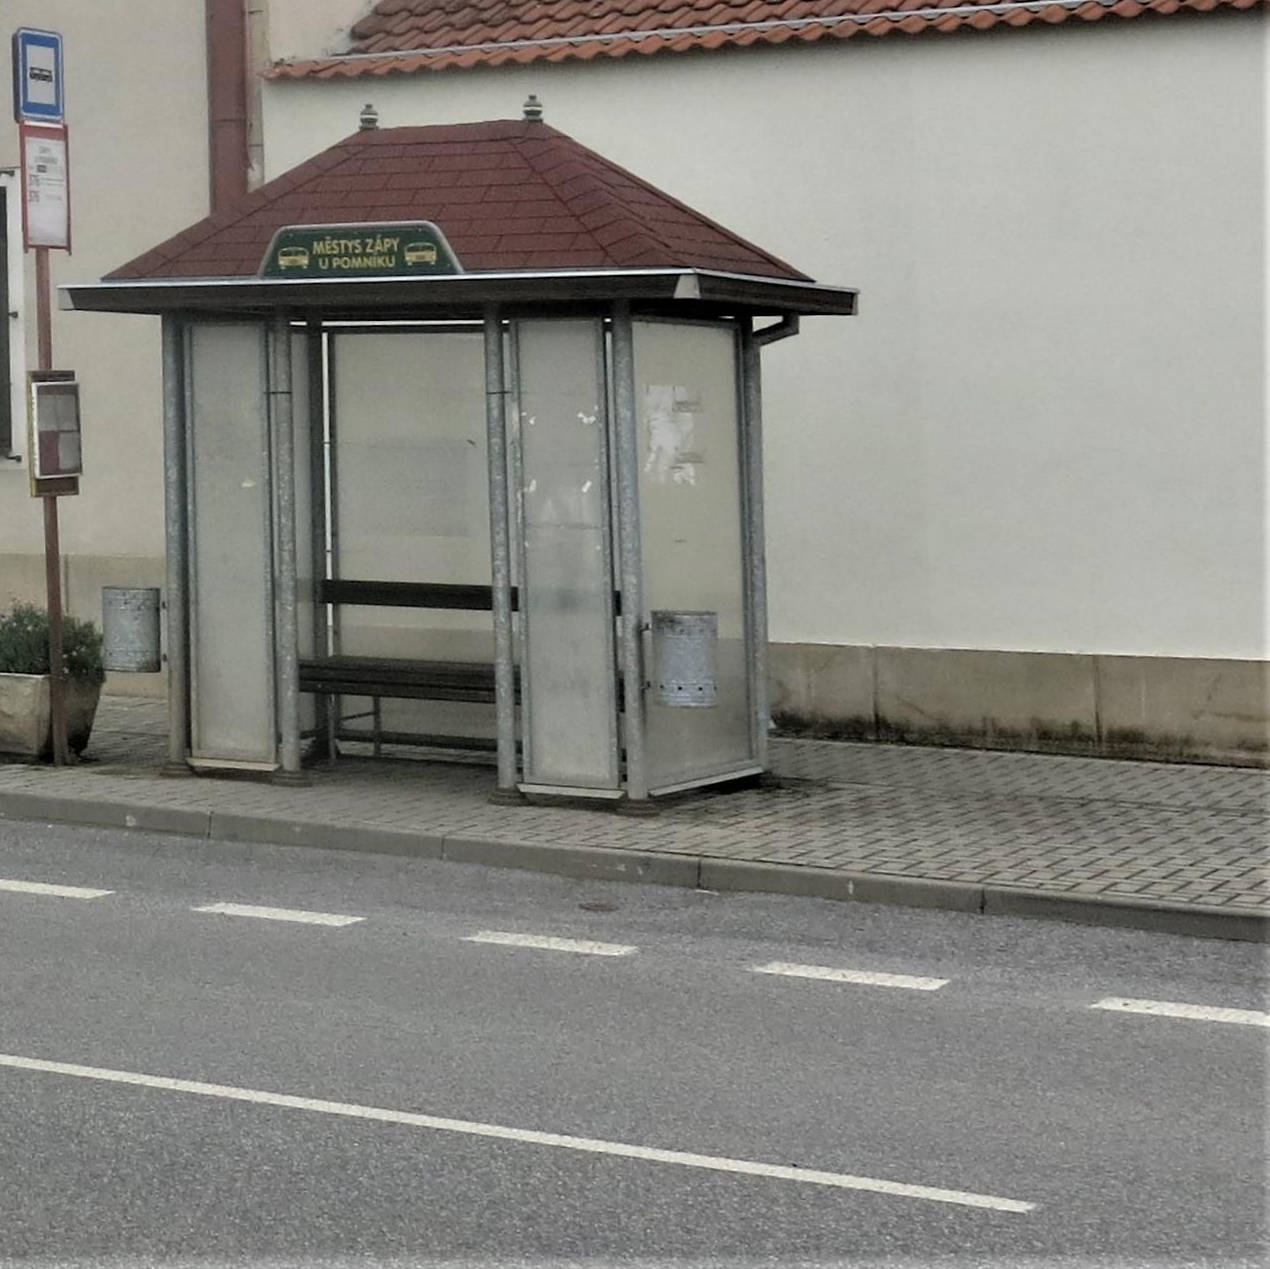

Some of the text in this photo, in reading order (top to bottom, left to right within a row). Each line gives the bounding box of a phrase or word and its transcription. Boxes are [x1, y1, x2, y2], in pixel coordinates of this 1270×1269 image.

[313, 234, 400, 254] MĚSTYS ZÁPY
[319, 258, 329, 269] U
